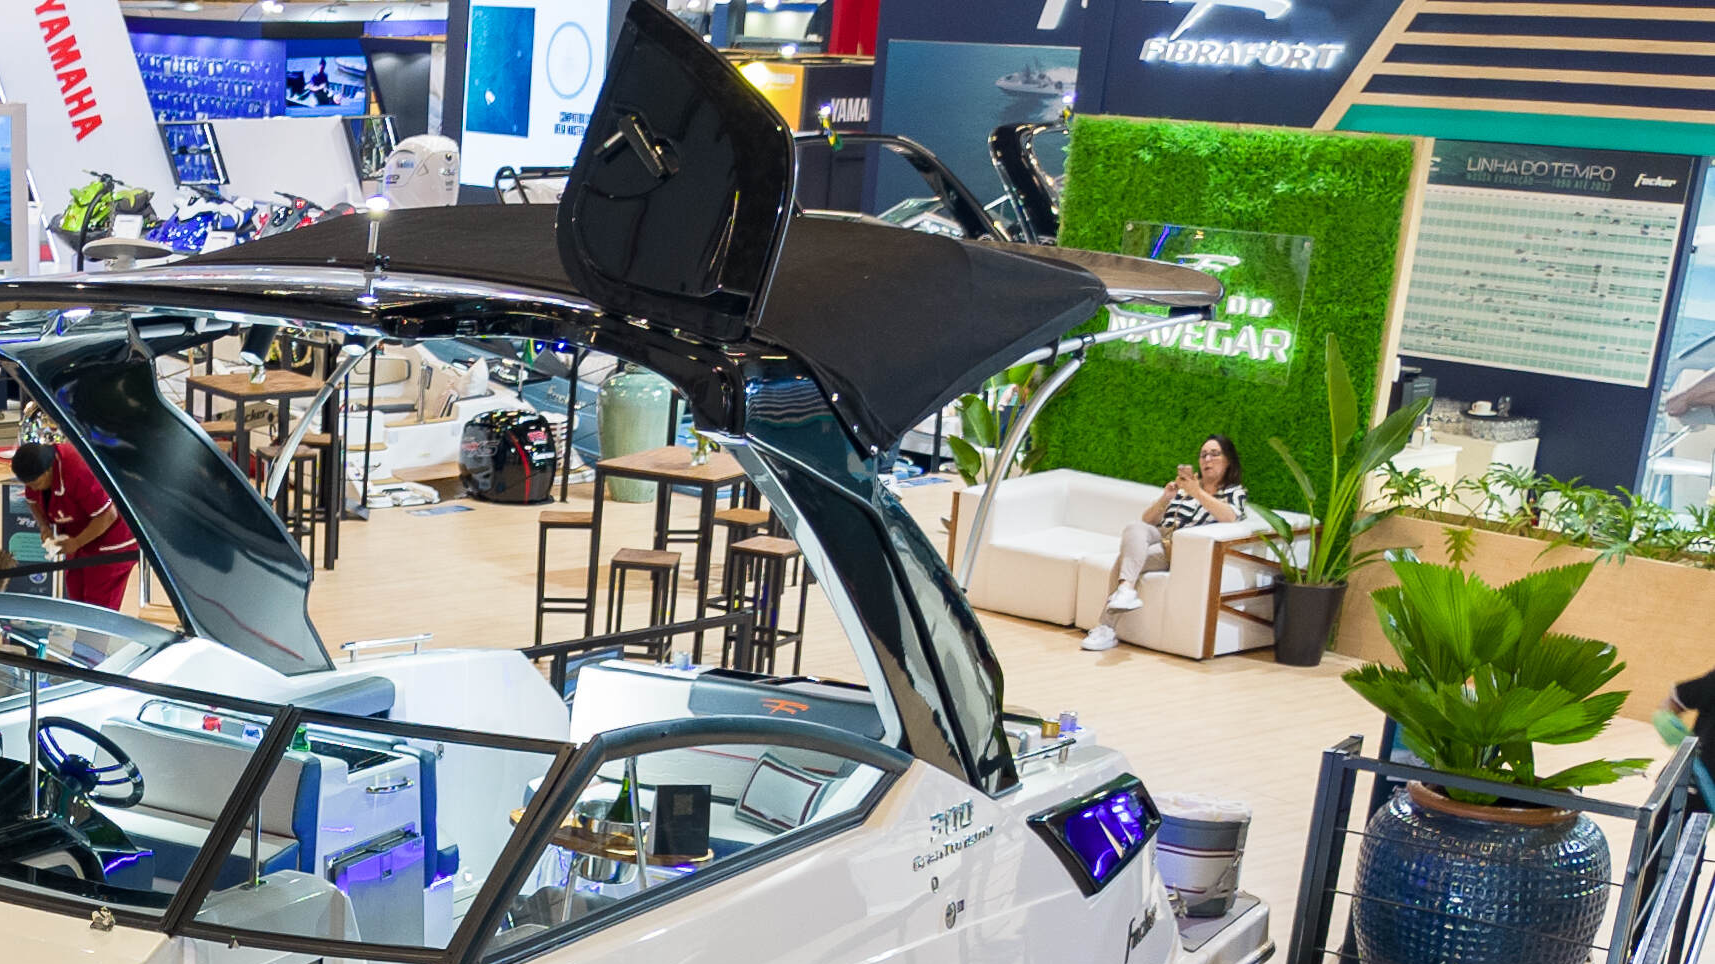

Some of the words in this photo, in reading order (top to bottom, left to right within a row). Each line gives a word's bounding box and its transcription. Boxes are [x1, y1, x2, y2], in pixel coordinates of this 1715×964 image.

[1139, 37, 1346, 70] FIBRAFORT
[34, 0, 102, 142] YAMAHA
[830, 98, 871, 122] YAMA
[1466, 157, 1519, 175] LINHA
[1521, 160, 1549, 177] DO
[1551, 162, 1616, 182] TEMPO
